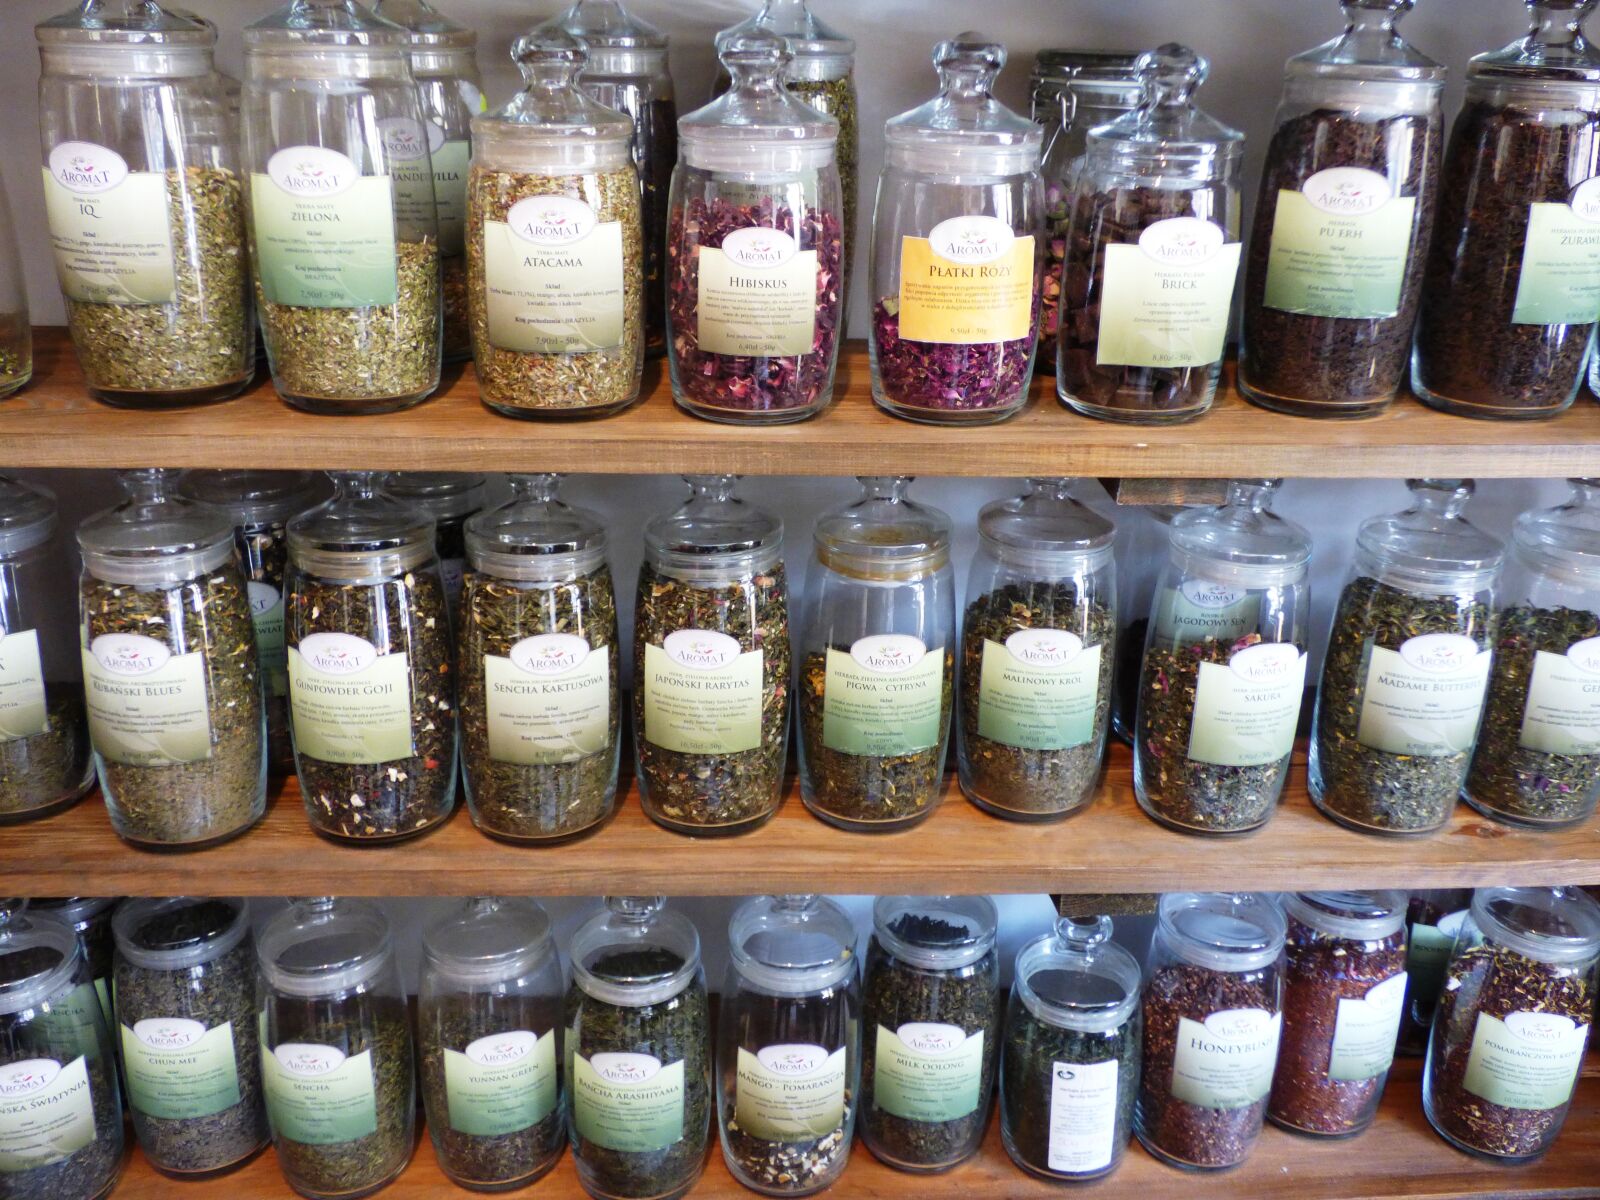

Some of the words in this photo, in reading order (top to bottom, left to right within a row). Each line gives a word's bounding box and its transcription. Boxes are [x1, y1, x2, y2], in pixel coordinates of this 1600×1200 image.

[61, 168, 109, 183] AROMAT
[283, 175, 339, 188] AROMAT
[79, 203, 103, 218] IQ
[291, 212, 340, 221] ZIELONA
[523, 223, 581, 236] AROMAT
[1319, 228, 1335, 237] PU
[945, 242, 998, 255] AROMAT
[1156, 245, 1208, 257] AROMAT
[736, 250, 784, 261] AROMAT
[523, 257, 583, 267] ATACAMA
[930, 266, 973, 277] PŁATKI
[980, 266, 1012, 277] RÓŻY
[730, 276, 787, 288] HIBISKUS
[1162, 279, 1197, 289] BRICK
[1193, 592, 1235, 601] AROMAT
[1174, 615, 1228, 626] JAGODOWY
[677, 651, 726, 663] AROMAT
[865, 655, 913, 666] AROMAT
[1021, 649, 1068, 660] AROMAT
[103, 656, 155, 668] AROMAT
[313, 656, 362, 667] AROMAT
[526, 654, 576, 668] AROMAT
[494, 682, 538, 694] SENCHA
[542, 676, 604, 693] KAKTUSOWA
[705, 680, 750, 689] RARYTAS
[1003, 673, 1056, 686] MALINOWY
[1378, 675, 1428, 692] MADAME
[146, 685, 182, 696] BLUES
[295, 678, 360, 696] GUNPOWDER
[363, 684, 393, 695] GOJI
[846, 681, 877, 691] PIGWA
[885, 681, 927, 692] CYTRYNA
[1244, 693, 1282, 703] SAKURA
[147, 1034, 192, 1045] AROMAT
[481, 1047, 526, 1062] AROMAT
[178, 1057, 197, 1065] MEE
[287, 1059, 330, 1071] AROMAT
[771, 1060, 815, 1070] AROMAT
[897, 1058, 920, 1068] MILK
[922, 1062, 964, 1070] OOLONG
[469, 1074, 509, 1083] YUNNAN
[511, 1064, 539, 1078] GREEN
[602, 1069, 647, 1079] AROMAT
[738, 1071, 772, 1089] MANGO
[30, 1079, 87, 1109] ŚWIĄTYNIA
[616, 1085, 679, 1100] ARASHIYAMA
